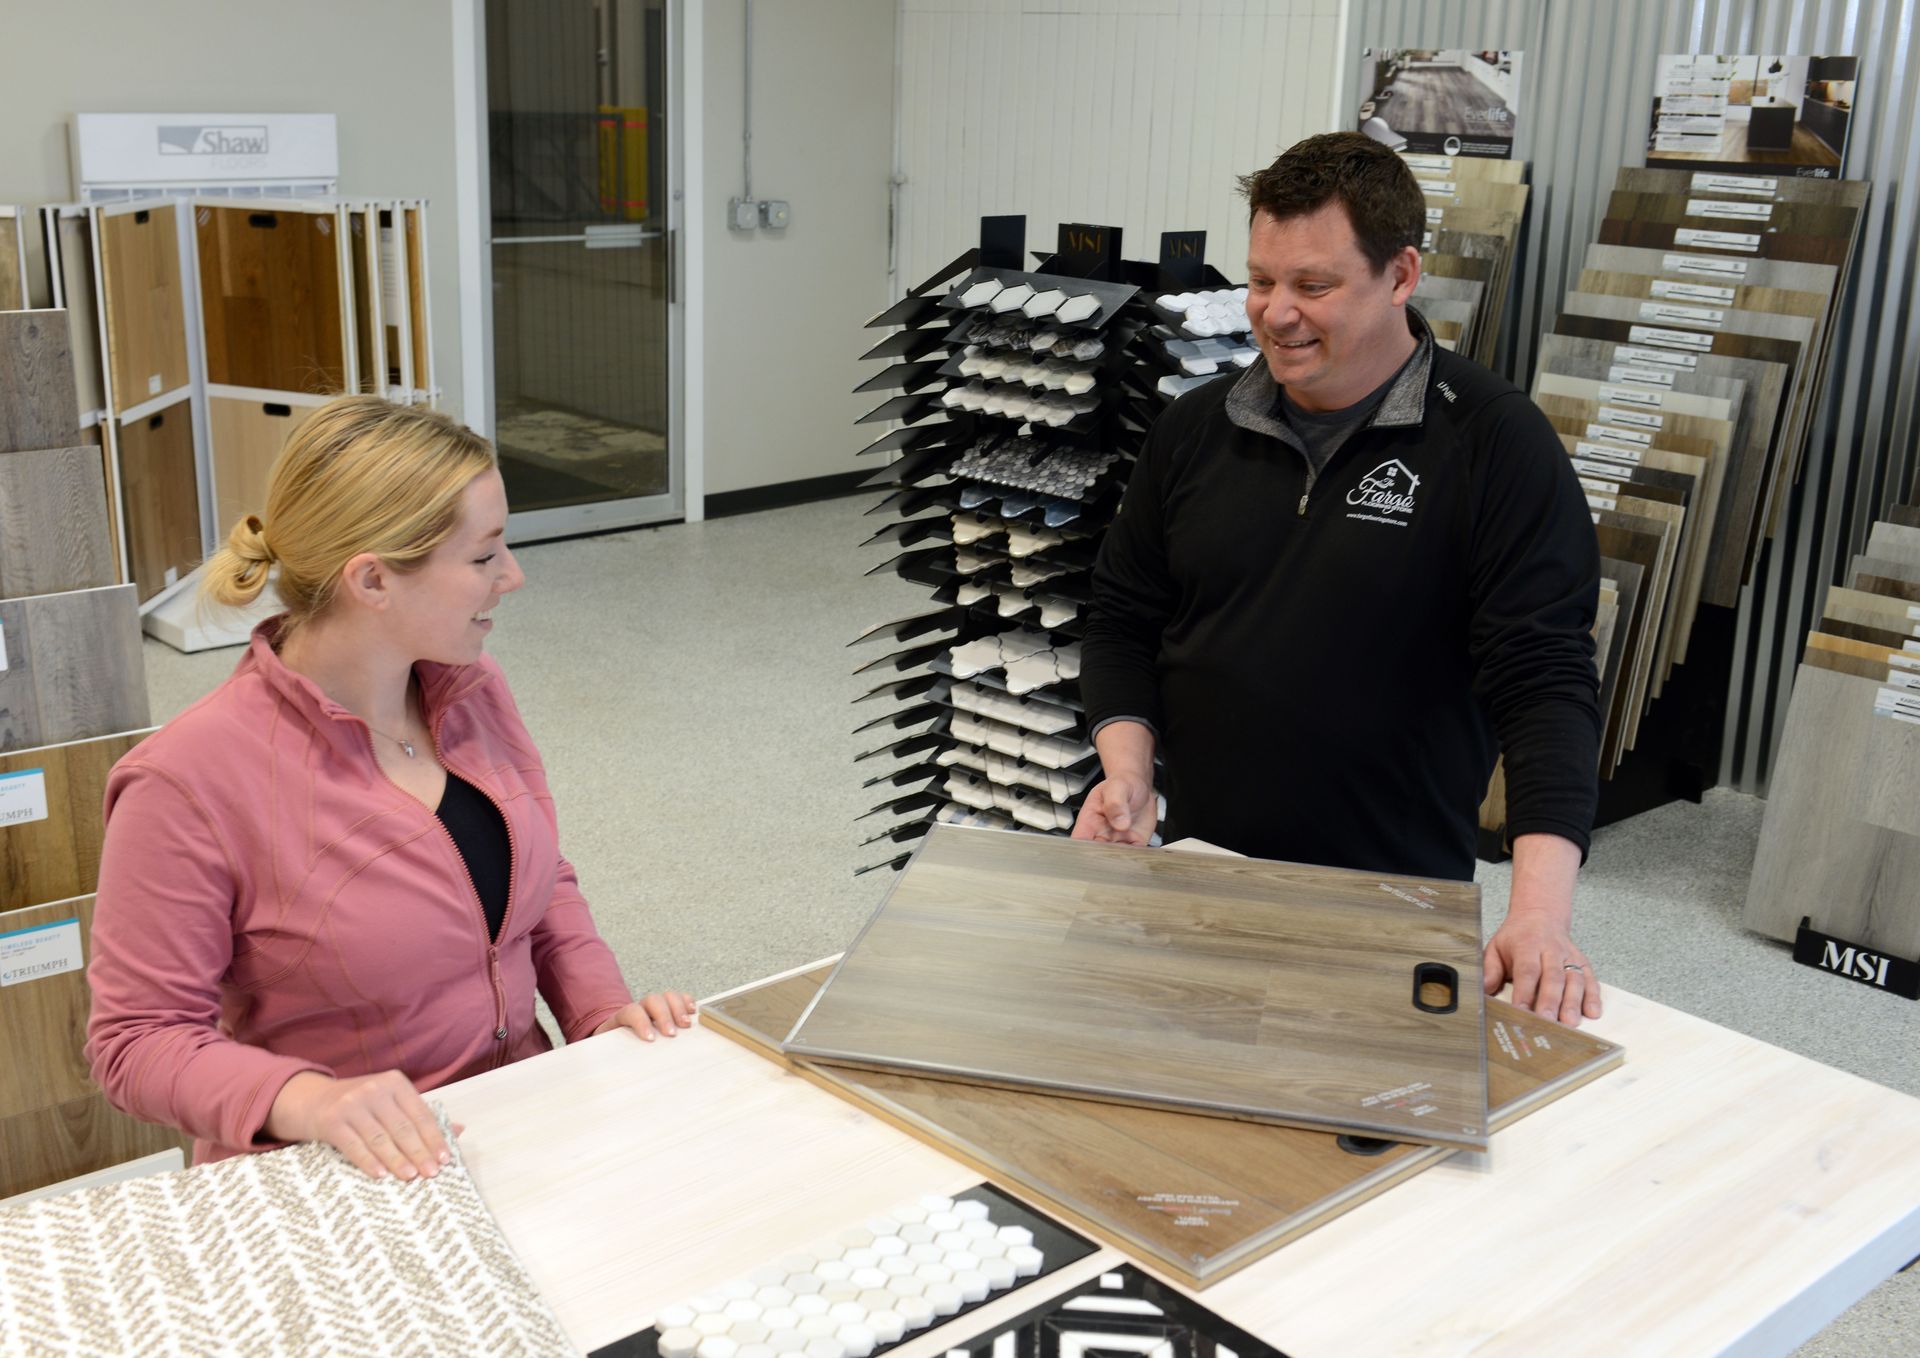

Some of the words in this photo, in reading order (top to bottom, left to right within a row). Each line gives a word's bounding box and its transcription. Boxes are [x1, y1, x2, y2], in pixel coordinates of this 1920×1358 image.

[202, 129, 265, 154] Shaw
[1346, 477, 1416, 514] Fargo
[12, 958, 68, 977] TRIUMPH
[1818, 940, 1891, 987] MSI
